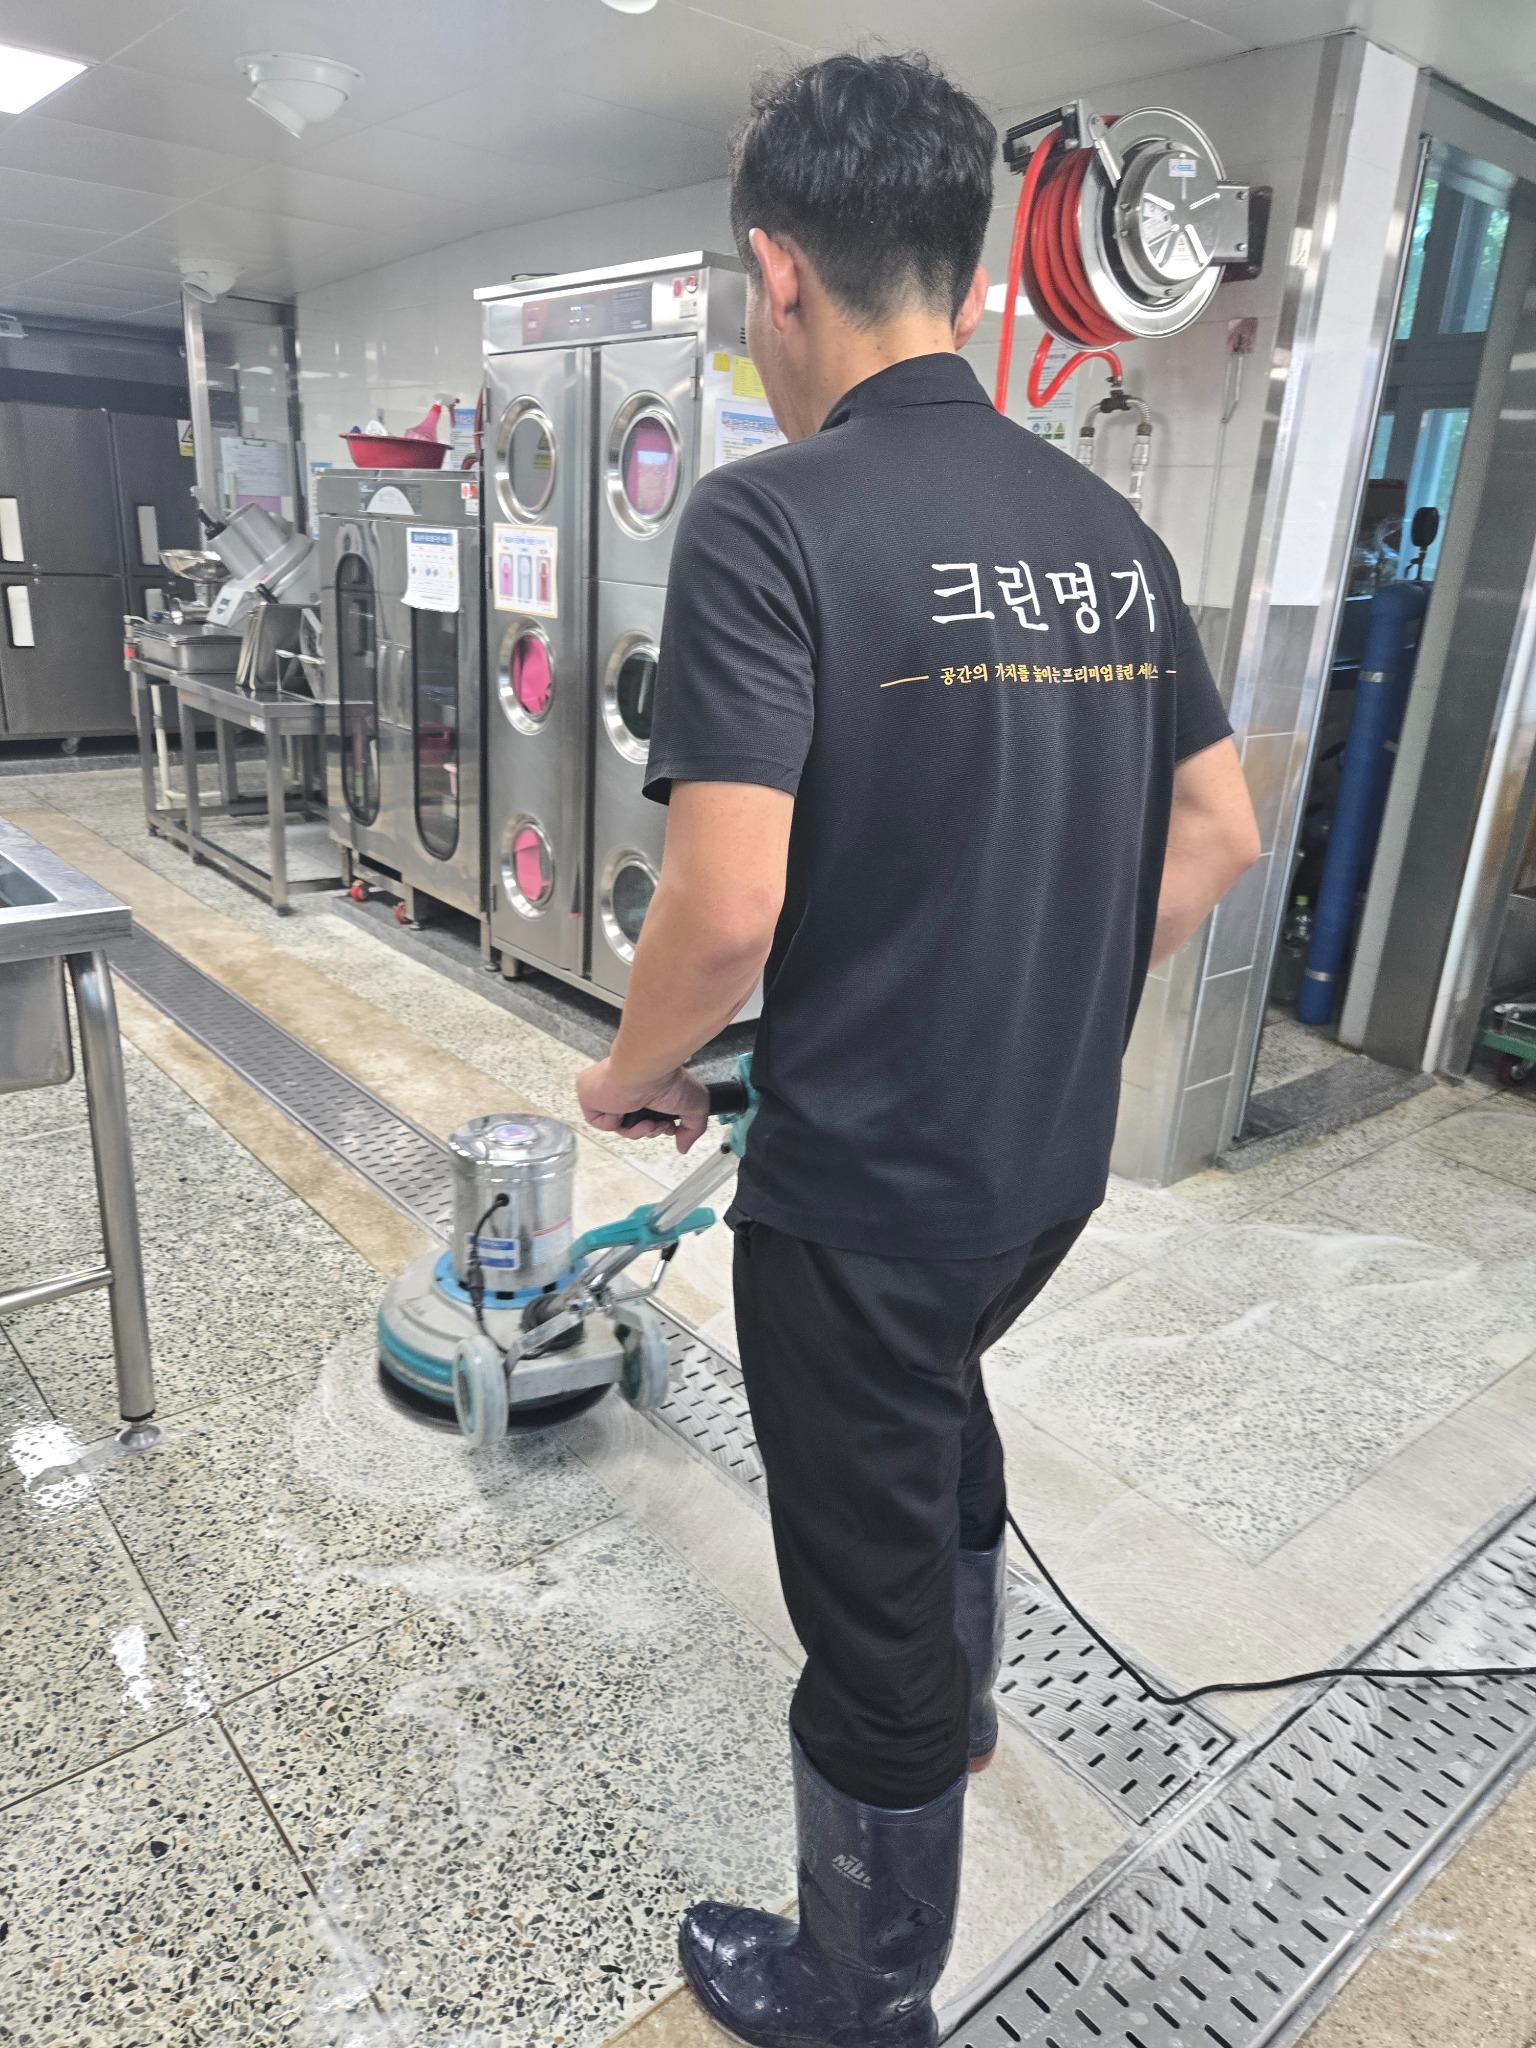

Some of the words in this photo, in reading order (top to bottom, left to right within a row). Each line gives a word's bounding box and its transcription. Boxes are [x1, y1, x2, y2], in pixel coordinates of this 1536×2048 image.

[931, 559, 1156, 635] 크린명가
[940, 663, 988, 685] 공간의
[995, 663, 1030, 683] 가치를
